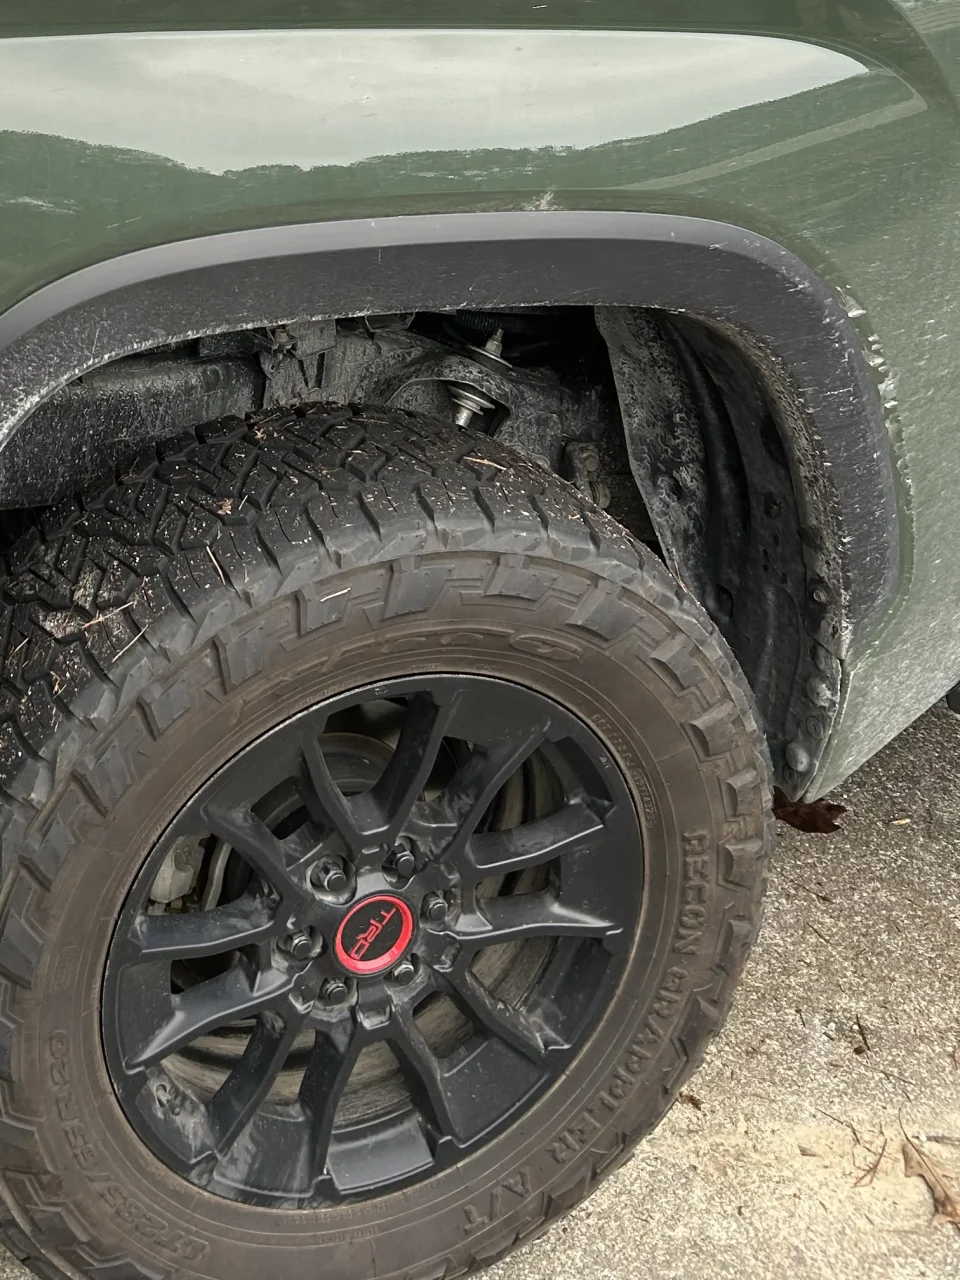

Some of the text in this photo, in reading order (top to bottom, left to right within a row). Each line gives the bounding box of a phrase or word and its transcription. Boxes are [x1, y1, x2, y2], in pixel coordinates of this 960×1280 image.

[349, 907, 397, 960] TRD
[463, 830, 711, 1236] RECON GRAPPLER A/T
